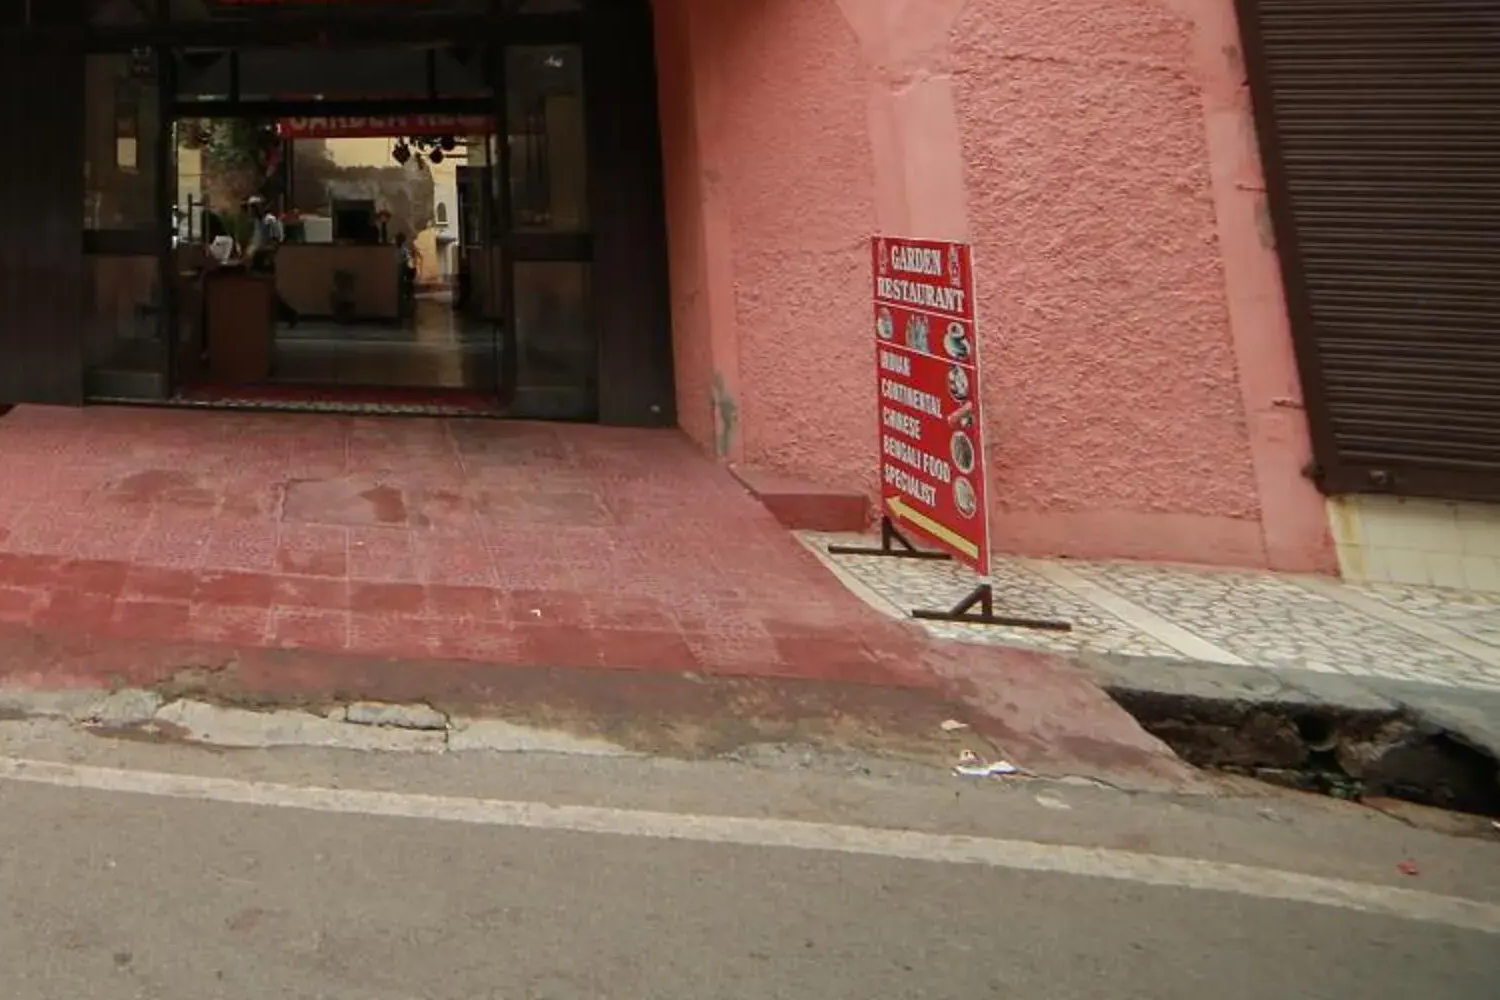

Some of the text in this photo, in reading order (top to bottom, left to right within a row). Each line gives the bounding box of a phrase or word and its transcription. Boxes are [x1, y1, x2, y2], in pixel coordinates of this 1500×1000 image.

[891, 245, 942, 276] GARDEN
[877, 277, 965, 313] RESTAURANT
[881, 377, 943, 419] CONTINENTAL
[883, 405, 921, 440] CHINESE
[884, 462, 936, 508] SPECIALIST
[922, 453, 951, 483] FOOD
